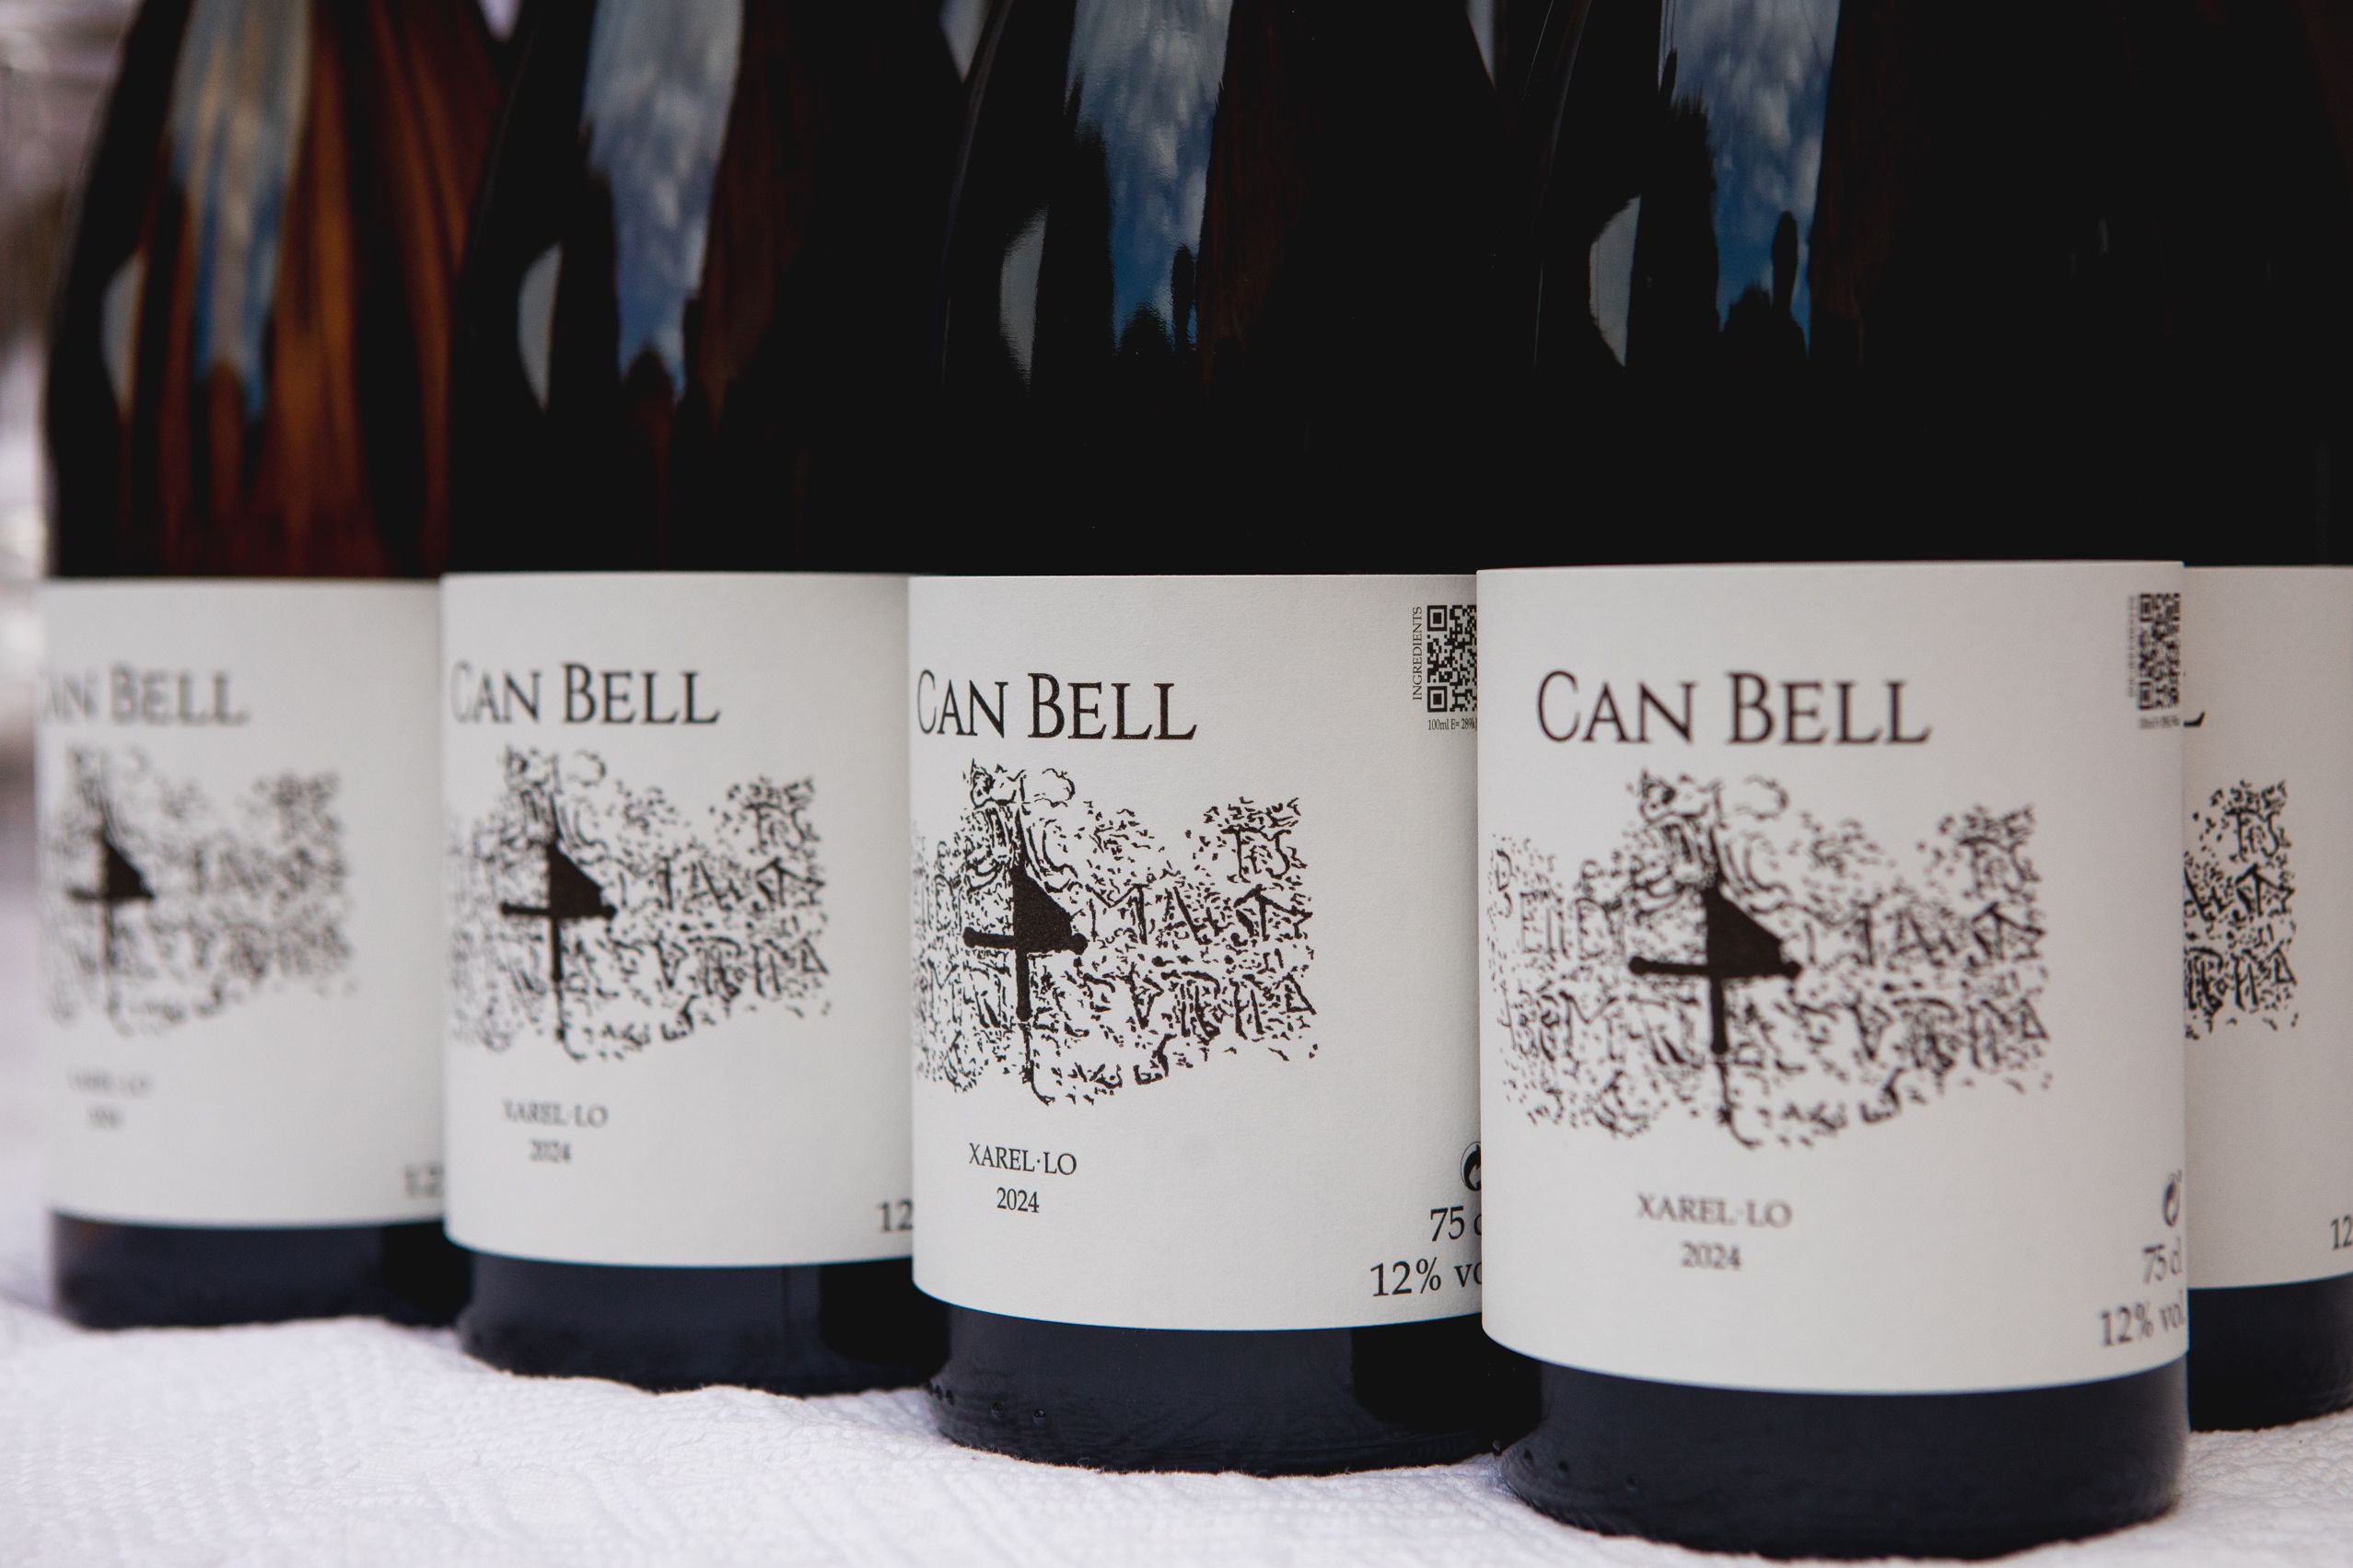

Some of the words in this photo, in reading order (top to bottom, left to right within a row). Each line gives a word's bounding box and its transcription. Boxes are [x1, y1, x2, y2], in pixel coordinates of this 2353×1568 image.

[1412, 606, 1423, 701] INGREDIENTS
[108, 659, 251, 726] BELL
[451, 658, 542, 725] CAN
[561, 661, 722, 726] BELL
[917, 669, 1008, 738] CAN
[1028, 673, 1197, 740] BELL
[1537, 669, 1699, 745] CAN
[1726, 670, 1933, 747] BELL
[877, 1199, 914, 1233] 12
[996, 1186, 1040, 1214] 2024
[1430, 1205, 1465, 1242] 75
[2330, 1214, 2353, 1250] 12
[1681, 1240, 1742, 1271] 2024
[2142, 1243, 2168, 1284] 75
[1370, 1256, 1442, 1297] 12%
[1454, 1261, 1482, 1288] vo
[2100, 1301, 2155, 1347] 12%
